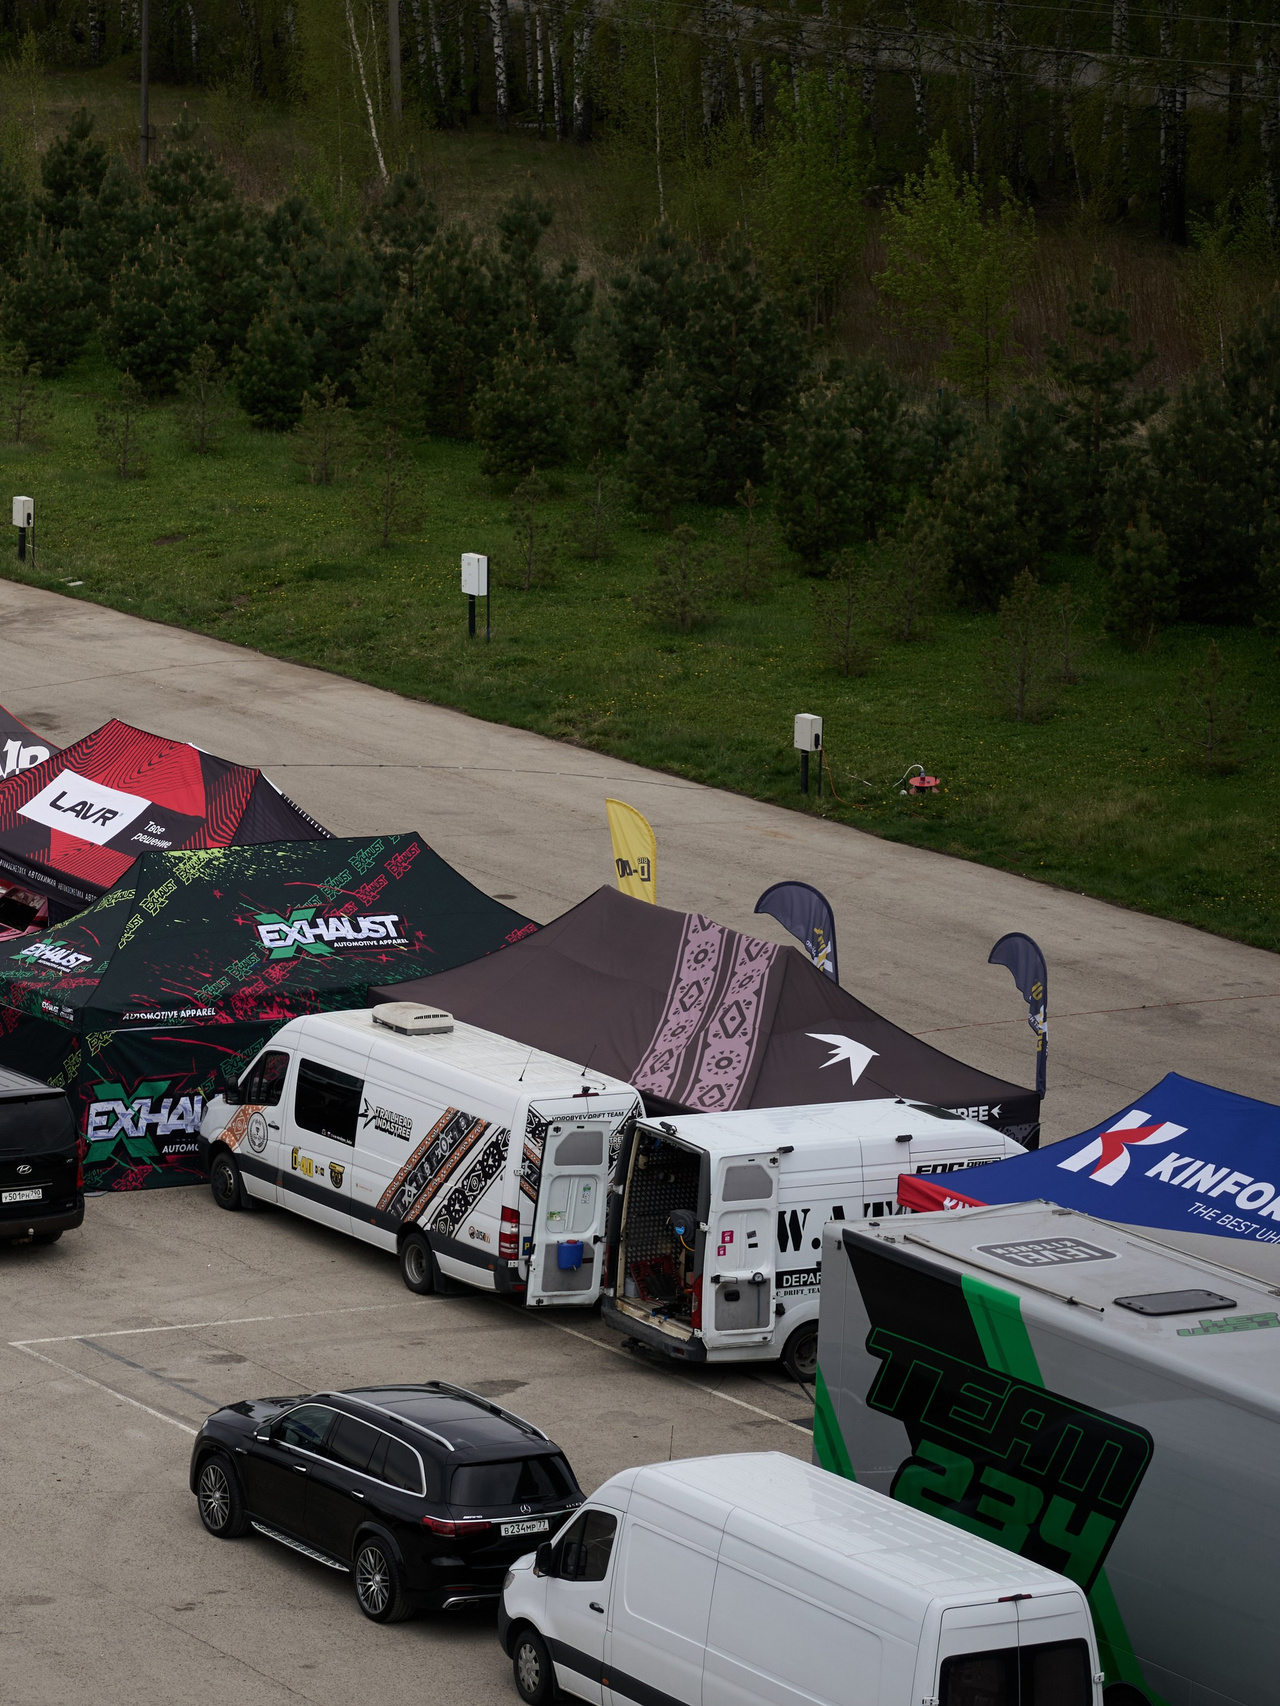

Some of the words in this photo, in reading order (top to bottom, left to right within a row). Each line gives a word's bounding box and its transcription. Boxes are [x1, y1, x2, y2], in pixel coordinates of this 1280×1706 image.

[49, 790, 119, 827] LAVR
[144, 820, 166, 835] Твое
[131, 832, 173, 849] решение
[28, 870, 57, 888] АВТОХИМИЯ
[257, 914, 400, 948] EXHAUST
[333, 940, 378, 948] AUTOMOTIVE
[379, 938, 409, 946] APPAREL
[21, 943, 93, 968] EXHAUST
[122, 1008, 179, 1021] AUTOMOTIVE
[179, 1007, 217, 1018] APPAREL
[375, 1106, 413, 1129] TRAILHEAD
[587, 1112, 606, 1120] DRIFT
[374, 1117, 412, 1140] INDASTREE
[1187, 1201, 1221, 1221] THE
[1216, 1212, 1256, 1234] BEST
[990, 1240, 1077, 1255] KITCHEN
[1005, 1246, 1103, 1264] LEVEL
[868, 1327, 1150, 1509] TEAM
[893, 1438, 1117, 1588] 234
[503, 1523, 537, 1535] В234МР
[537, 1520, 547, 1528] 77
